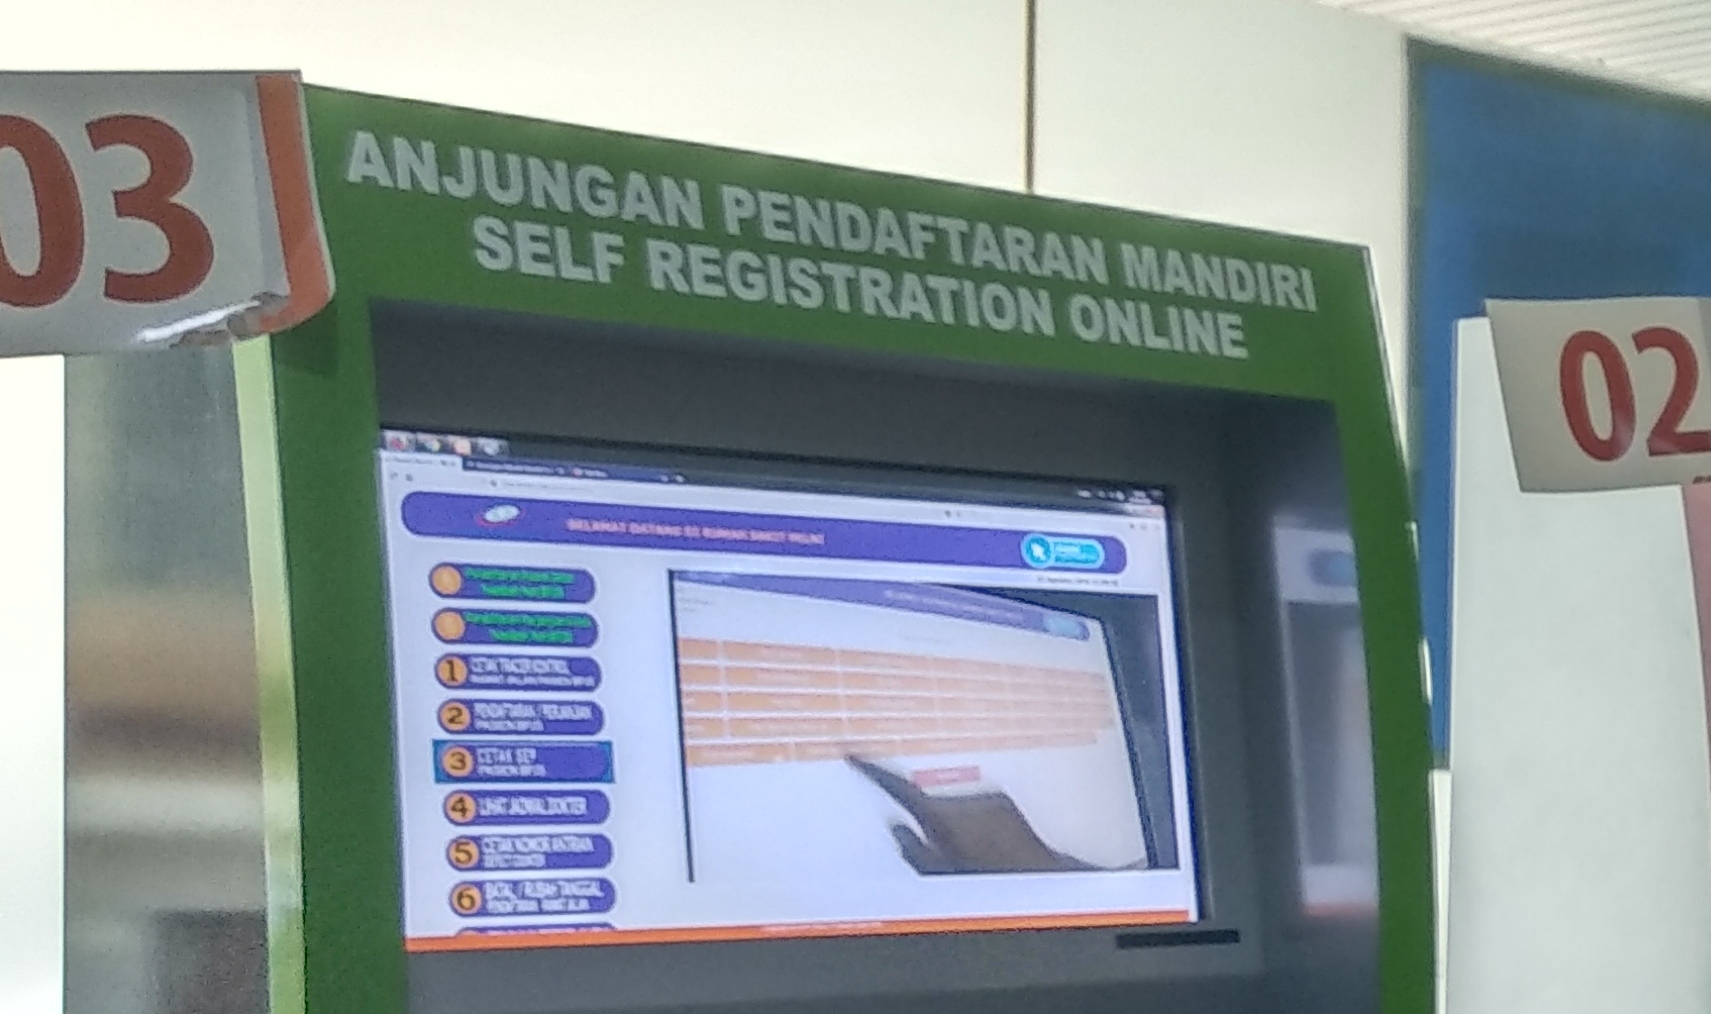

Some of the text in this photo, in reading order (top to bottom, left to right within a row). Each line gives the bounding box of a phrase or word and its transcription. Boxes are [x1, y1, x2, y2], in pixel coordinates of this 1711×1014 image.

[0, 112, 216, 309] 03
[347, 130, 1318, 313] ANJUNGAN PENDAFTARAN MANDIRI
[472, 215, 1250, 361] SELF REGISTRATION ONLINE
[446, 706, 464, 725] 2
[449, 751, 467, 770] 3
[450, 796, 470, 818] 4
[454, 841, 473, 865] 5
[456, 886, 476, 911] 6
